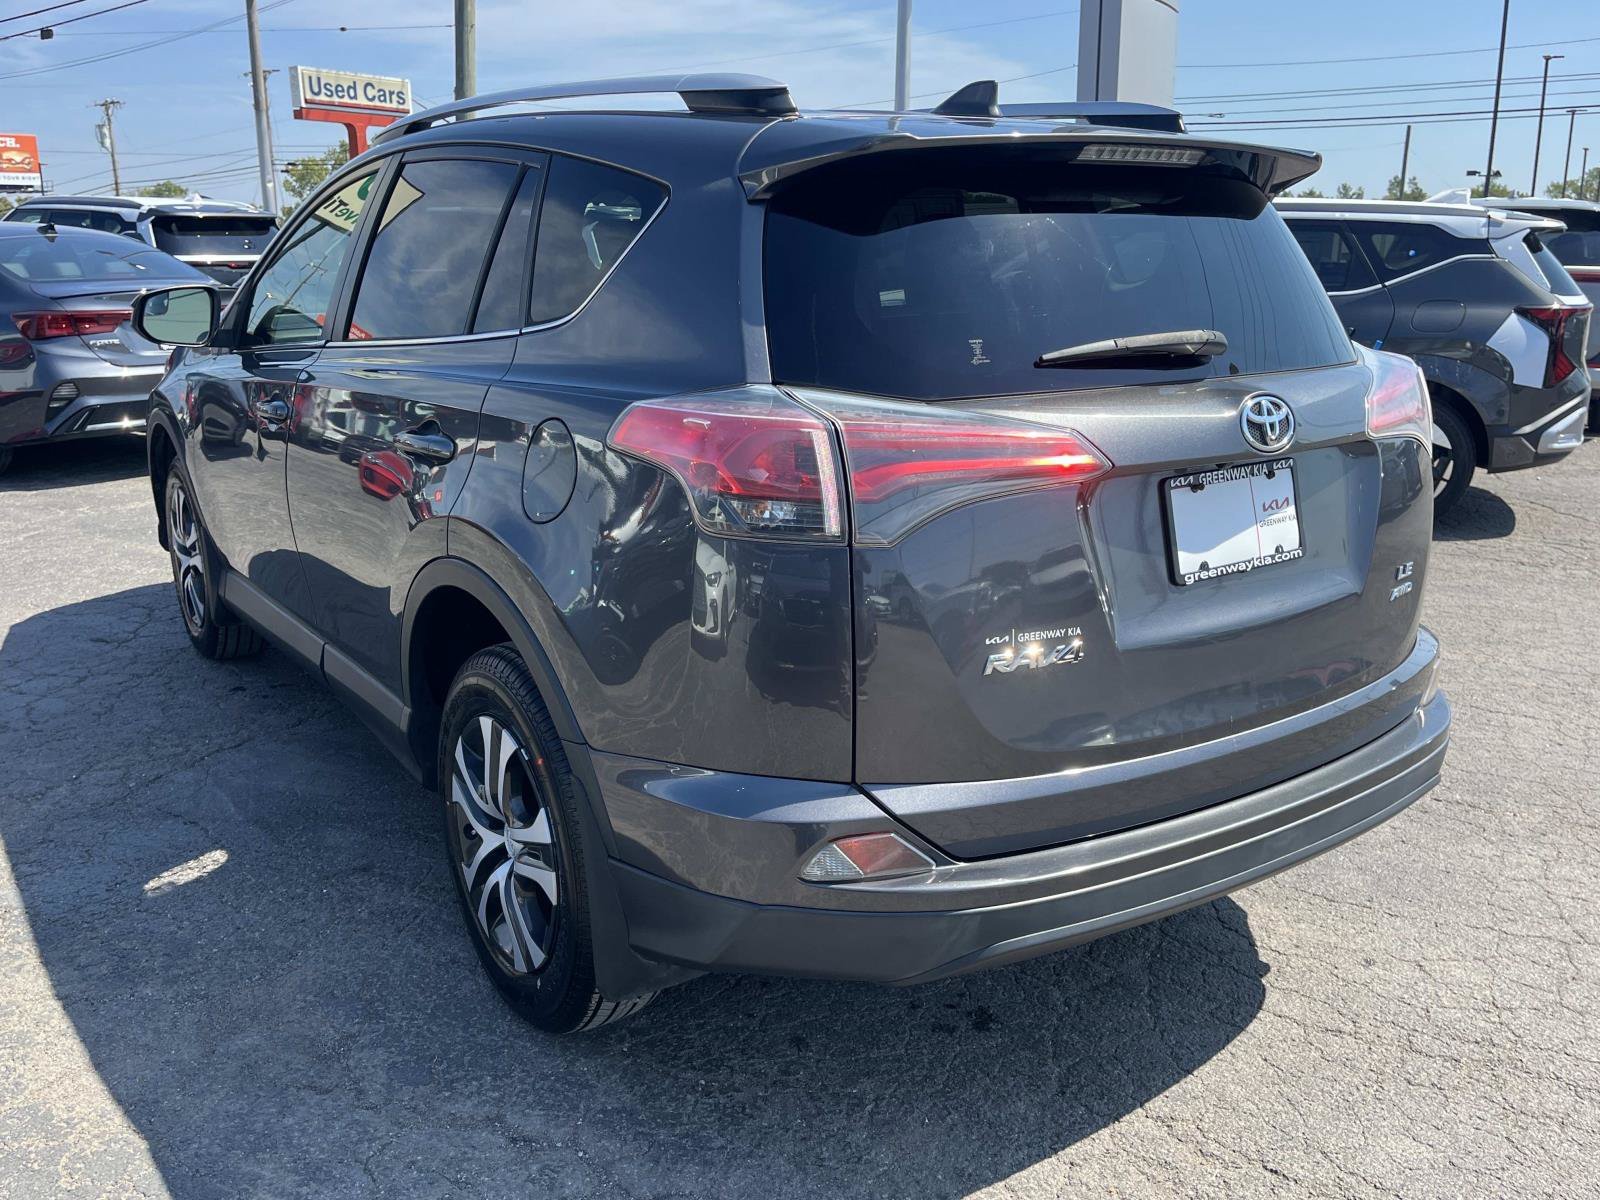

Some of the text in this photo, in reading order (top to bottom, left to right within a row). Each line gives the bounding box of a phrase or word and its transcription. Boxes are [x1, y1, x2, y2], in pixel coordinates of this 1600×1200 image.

[308, 75, 406, 105] Used Cars
[1199, 465, 1251, 485] GREENWAY
[1253, 463, 1269, 476] KIA
[1259, 515, 1287, 528] GREENWAY
[1184, 549, 1303, 585] greenwaykia.com
[1017, 628, 1066, 642] GREENWAY
[1067, 626, 1082, 636] KIA
[983, 640, 1085, 676] RAV4
